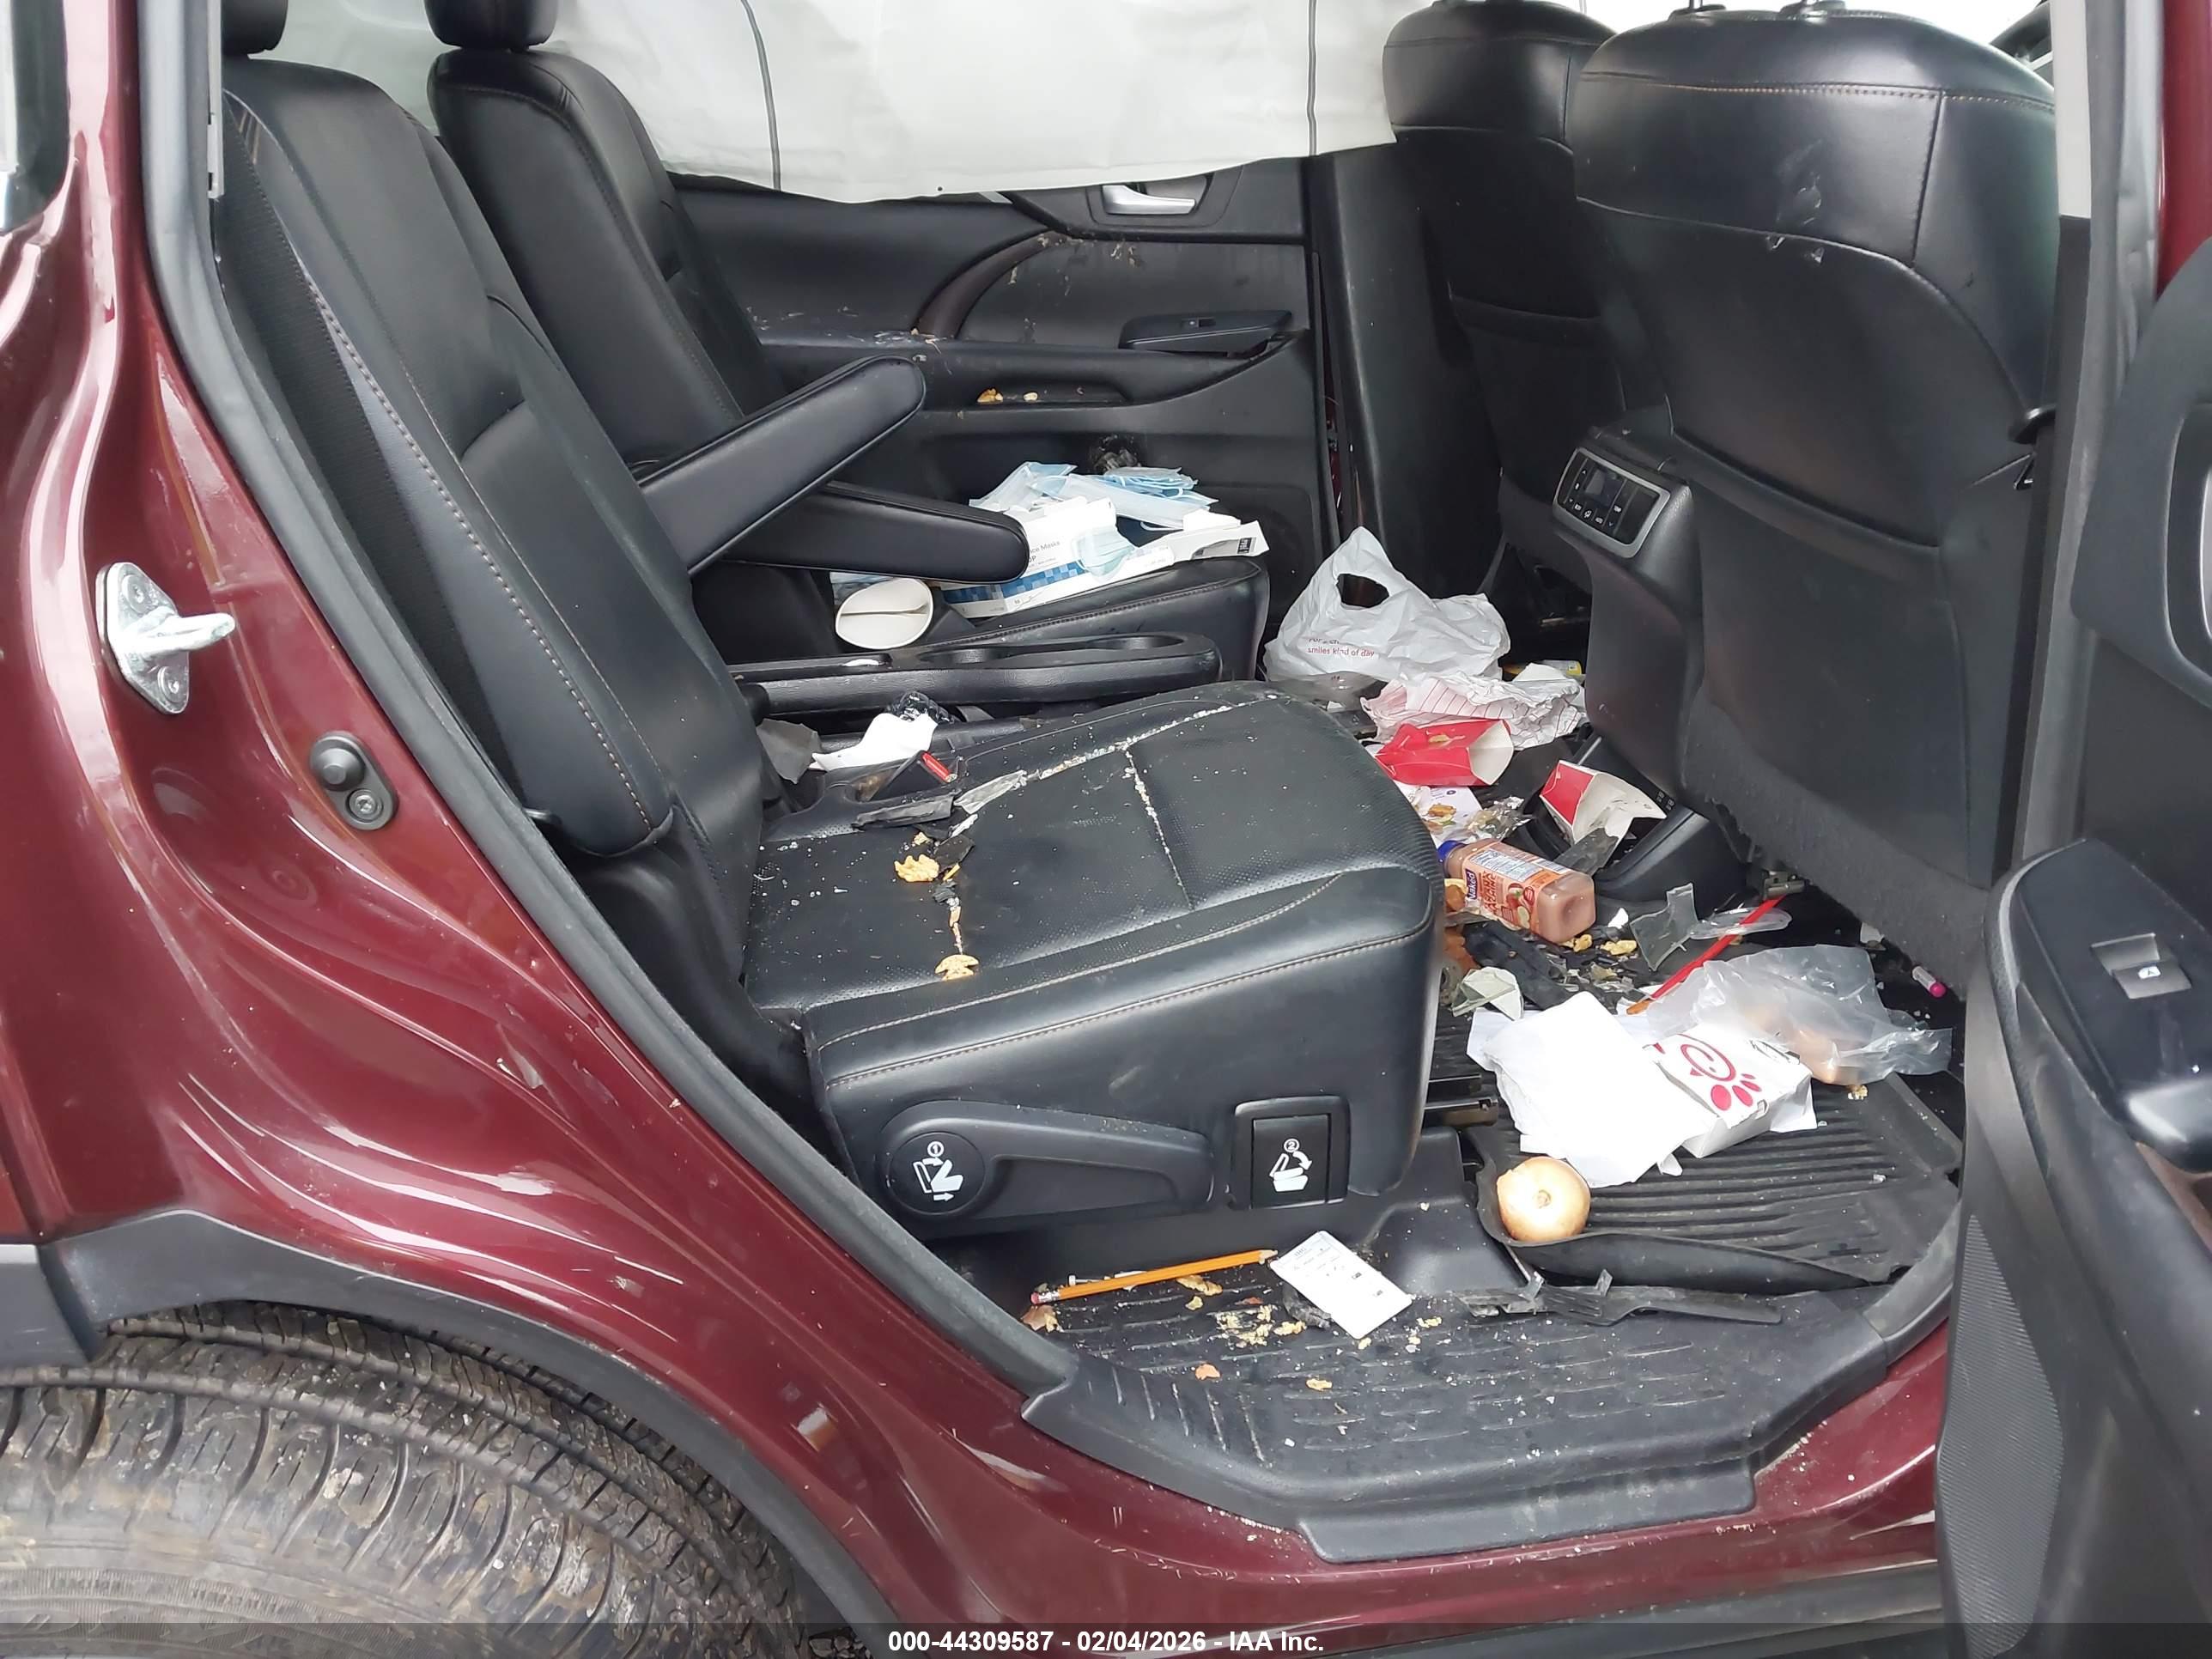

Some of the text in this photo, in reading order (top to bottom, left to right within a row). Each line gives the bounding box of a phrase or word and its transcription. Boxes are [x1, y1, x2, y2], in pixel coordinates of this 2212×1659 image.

[1308, 646, 1375, 658] smiles kind of day
